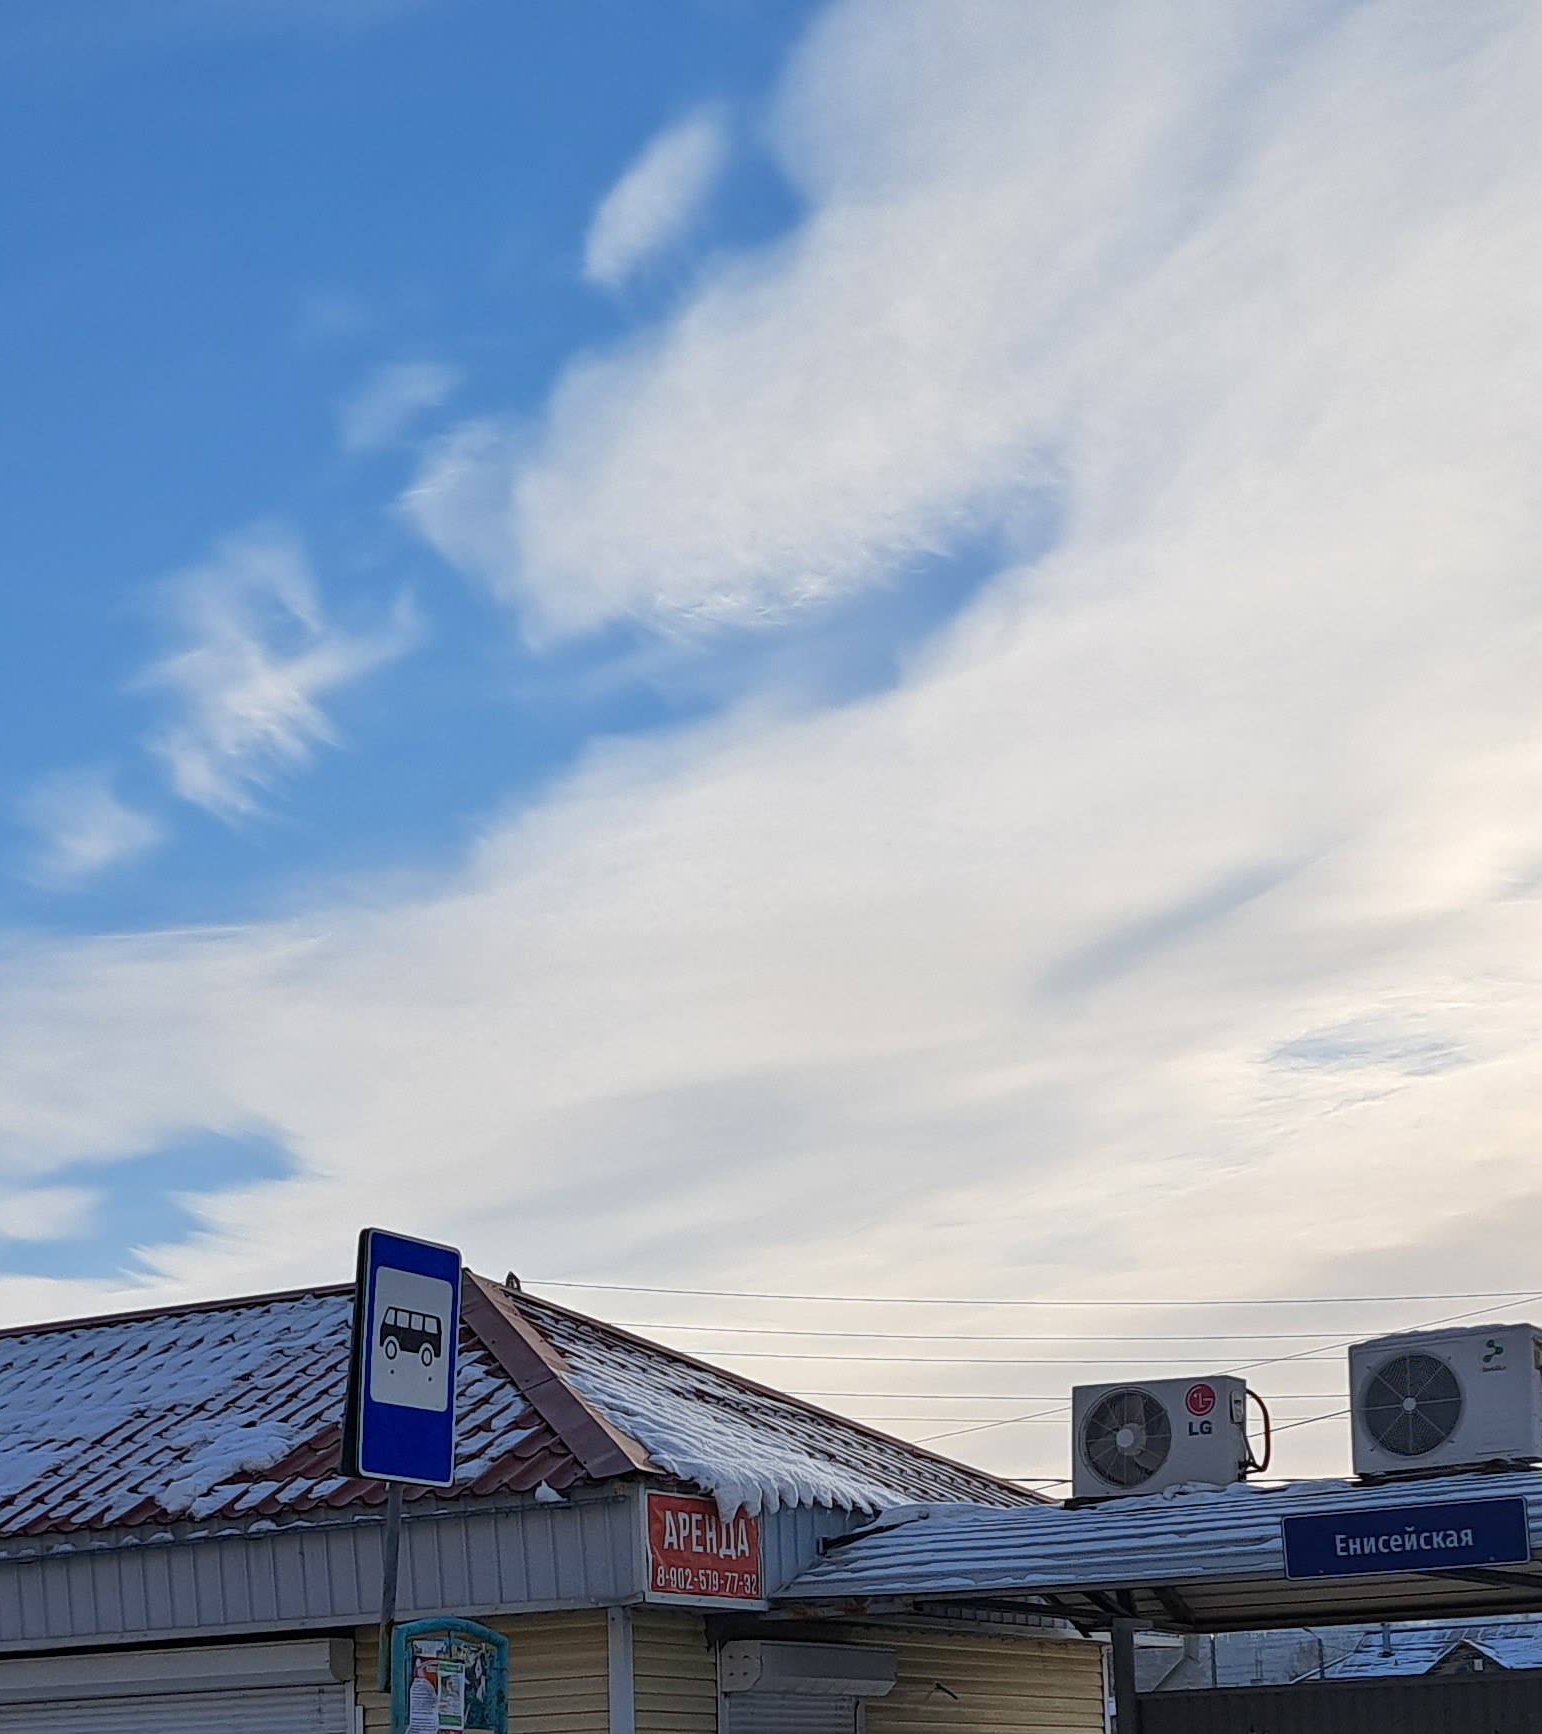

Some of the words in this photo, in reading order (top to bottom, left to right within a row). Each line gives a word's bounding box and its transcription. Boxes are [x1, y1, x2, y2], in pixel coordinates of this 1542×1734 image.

[1188, 1420, 1213, 1436] LG
[663, 1509, 750, 1561] АРЕНДА
[1334, 1525, 1474, 1556] Енисейская
